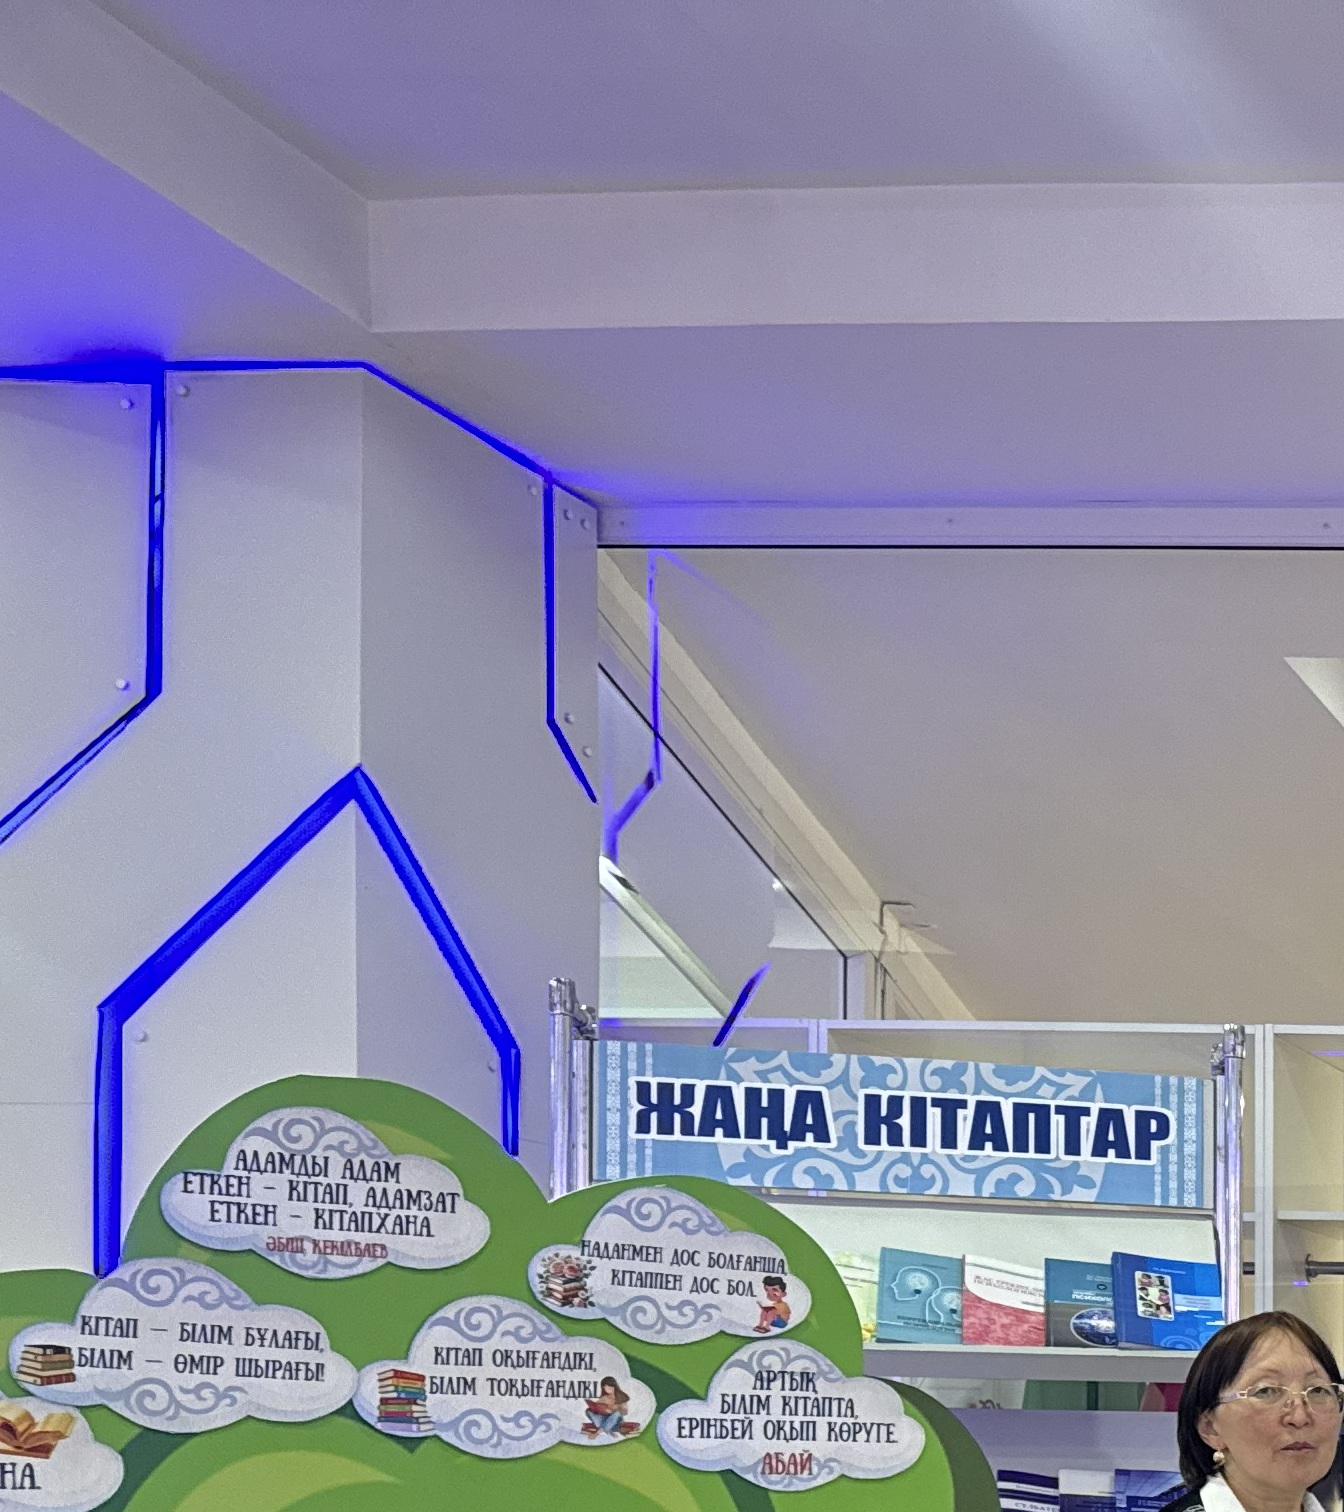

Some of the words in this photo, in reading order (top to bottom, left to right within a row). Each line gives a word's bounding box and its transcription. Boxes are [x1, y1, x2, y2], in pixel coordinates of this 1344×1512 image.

[635, 1080, 831, 1150] ЖАҢА
[863, 1094, 1171, 1162] КІТАПТАР
[233, 1149, 329, 1179] АДАМДЫ
[341, 1159, 401, 1184] АДАМ
[181, 1172, 251, 1198] ЕТКЕН
[288, 1180, 354, 1208] КІТАП,
[364, 1188, 460, 1214] АДАМЗАТ
[208, 1200, 278, 1226] ЕТКЕН
[312, 1239, 388, 1259] КЕКІЛБАЕВ
[581, 1239, 664, 1264] НАДАНМЕН
[669, 1245, 700, 1267] ДОС
[610, 1268, 683, 1292] КІТАППЕН
[689, 1273, 720, 1294] ДОС
[80, 1315, 139, 1339] КІТАП
[179, 1322, 234, 1346] БІЛІМ
[244, 1327, 325, 1353] БҰЛАҒЫ,
[77, 1347, 133, 1370] БІЛІМ
[174, 1353, 225, 1376] ӨМІР
[235, 1358, 325, 1382] ШЫРАҒЫ!
[433, 1347, 483, 1367] КІТАП
[492, 1348, 597, 1373] ОҚЫҒАНДІКІ,
[429, 1376, 477, 1397] БІЛІМ
[752, 1370, 817, 1393] АРТЫҚ
[720, 1393, 770, 1417] БІЛІМ
[781, 1395, 859, 1420] КІТАПТА,
[676, 1416, 754, 1440] ЕРІНБЕЙ
[764, 1420, 817, 1444] ОҚЫП
[761, 1450, 813, 1476] АБАЙ
